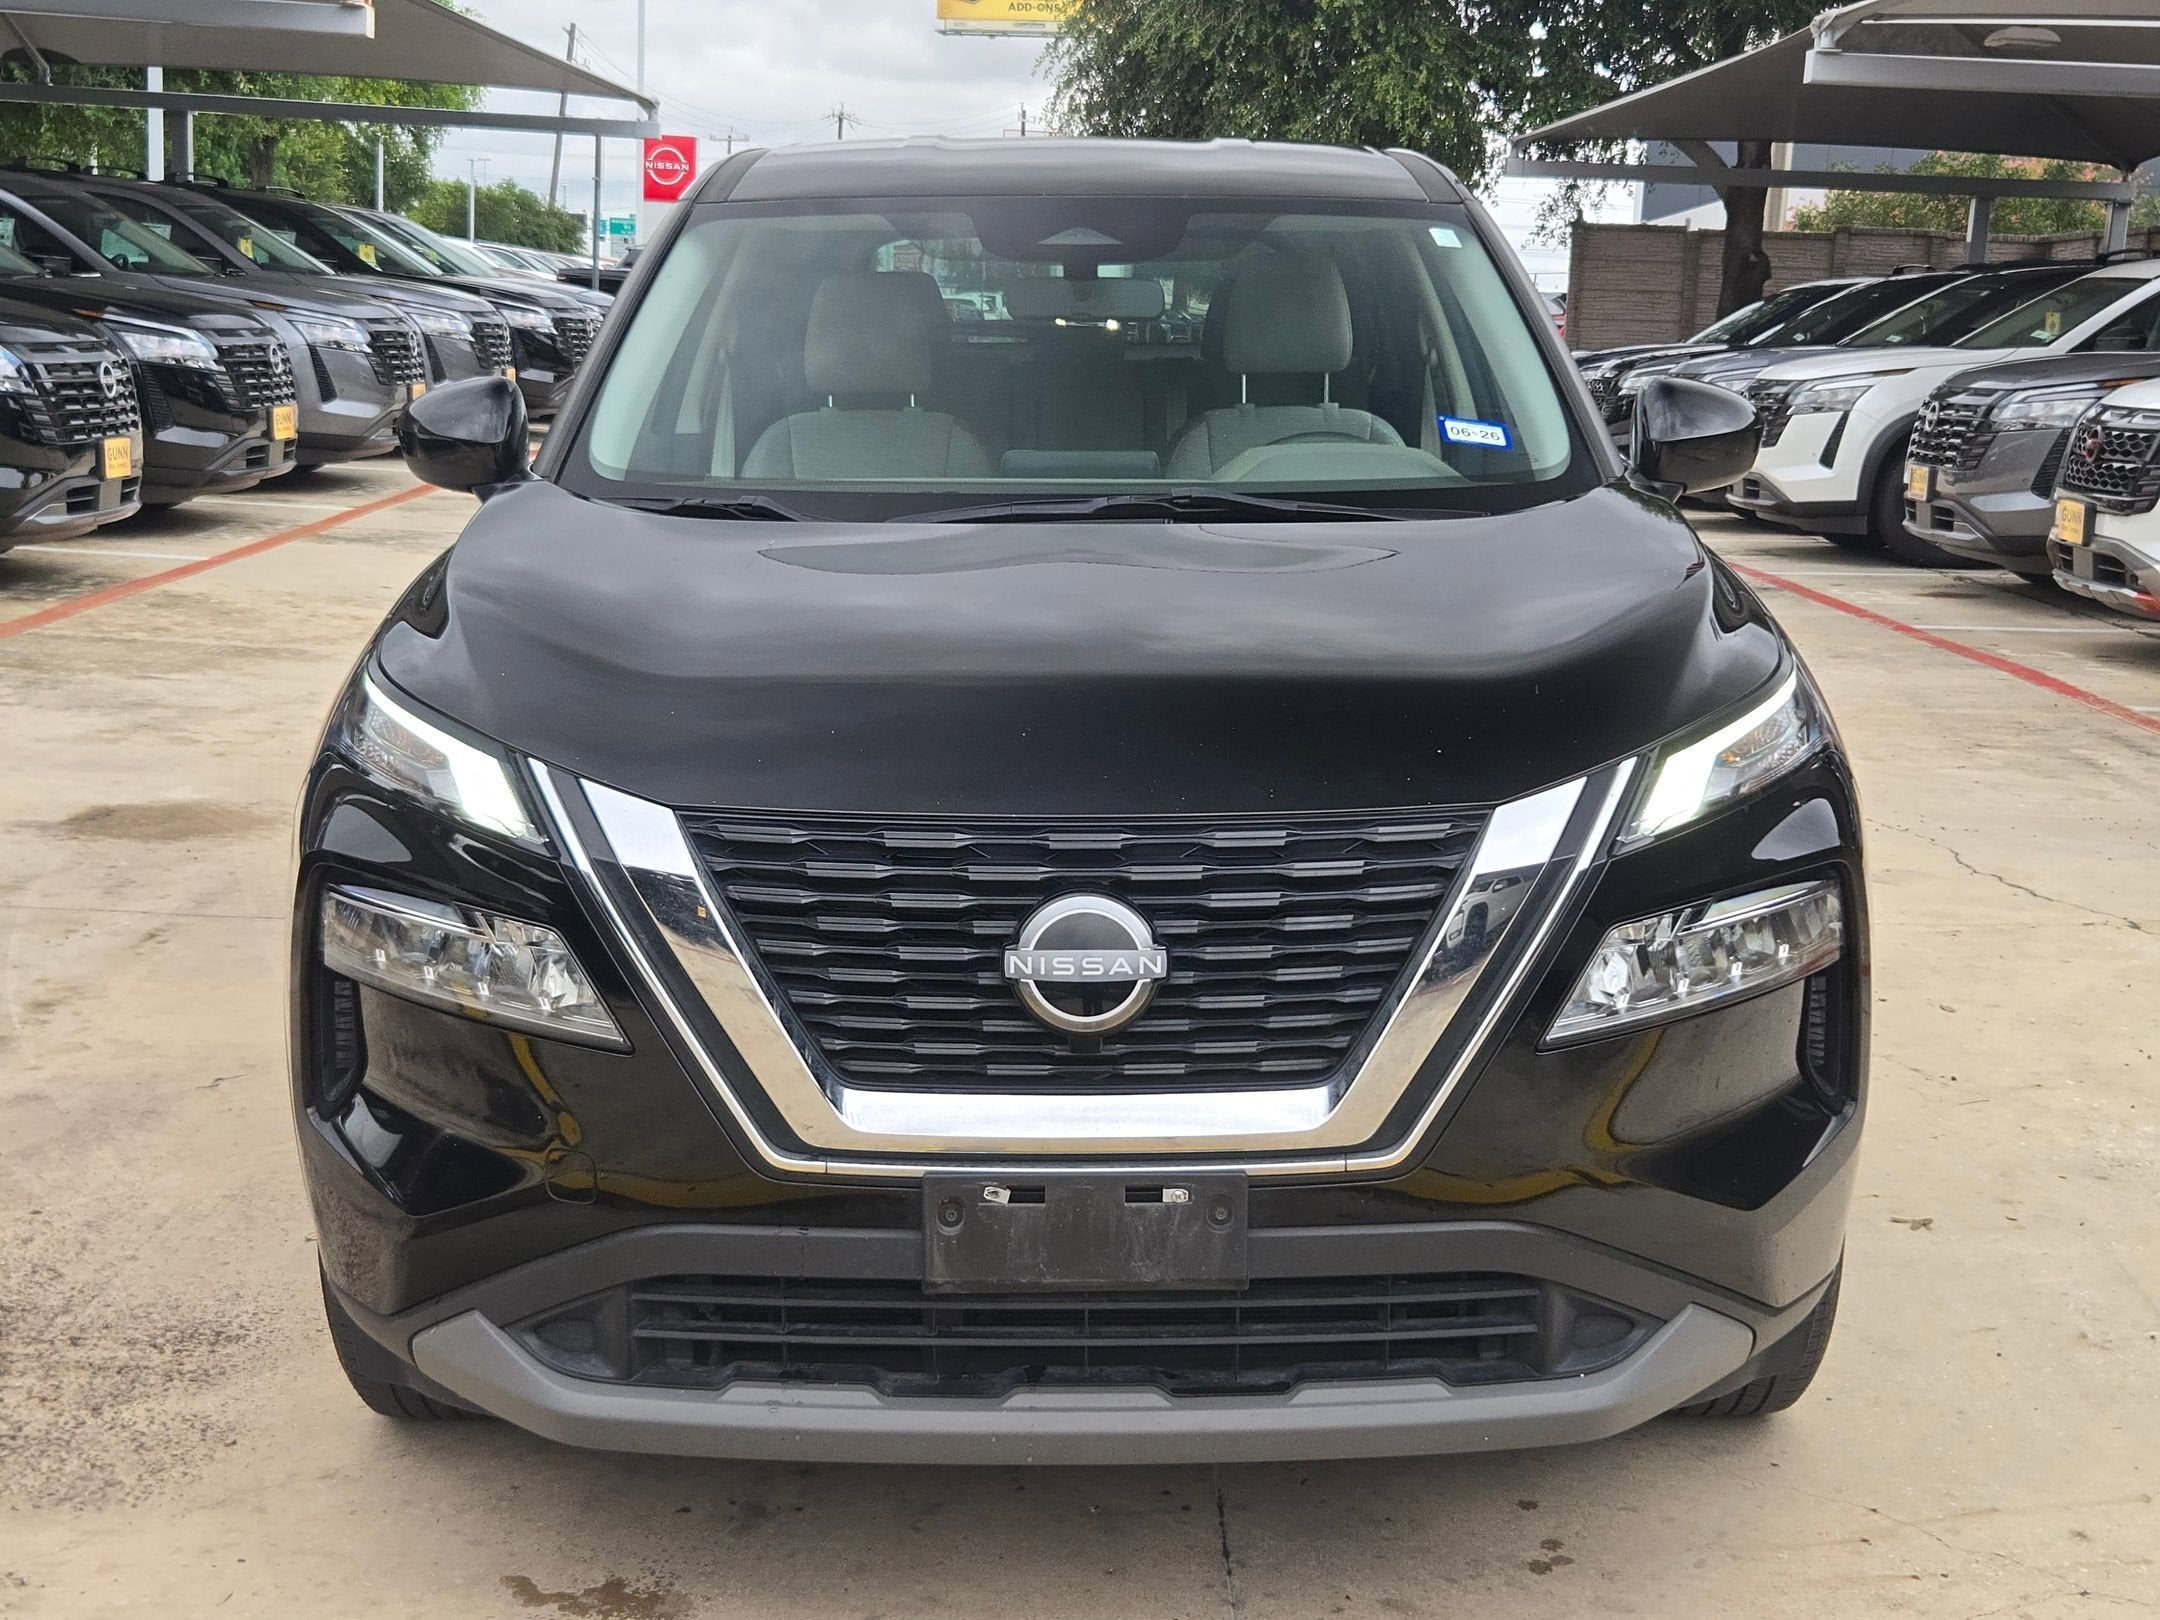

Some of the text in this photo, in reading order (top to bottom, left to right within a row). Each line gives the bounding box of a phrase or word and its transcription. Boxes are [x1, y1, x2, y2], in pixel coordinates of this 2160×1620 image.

[1008, 2, 1060, 12] ADD-ONS
[645, 161, 689, 171] NISSAN
[1450, 426, 1500, 441] 06-26
[107, 445, 129, 461] GUNN
[1009, 955, 1162, 976] NISSAN
